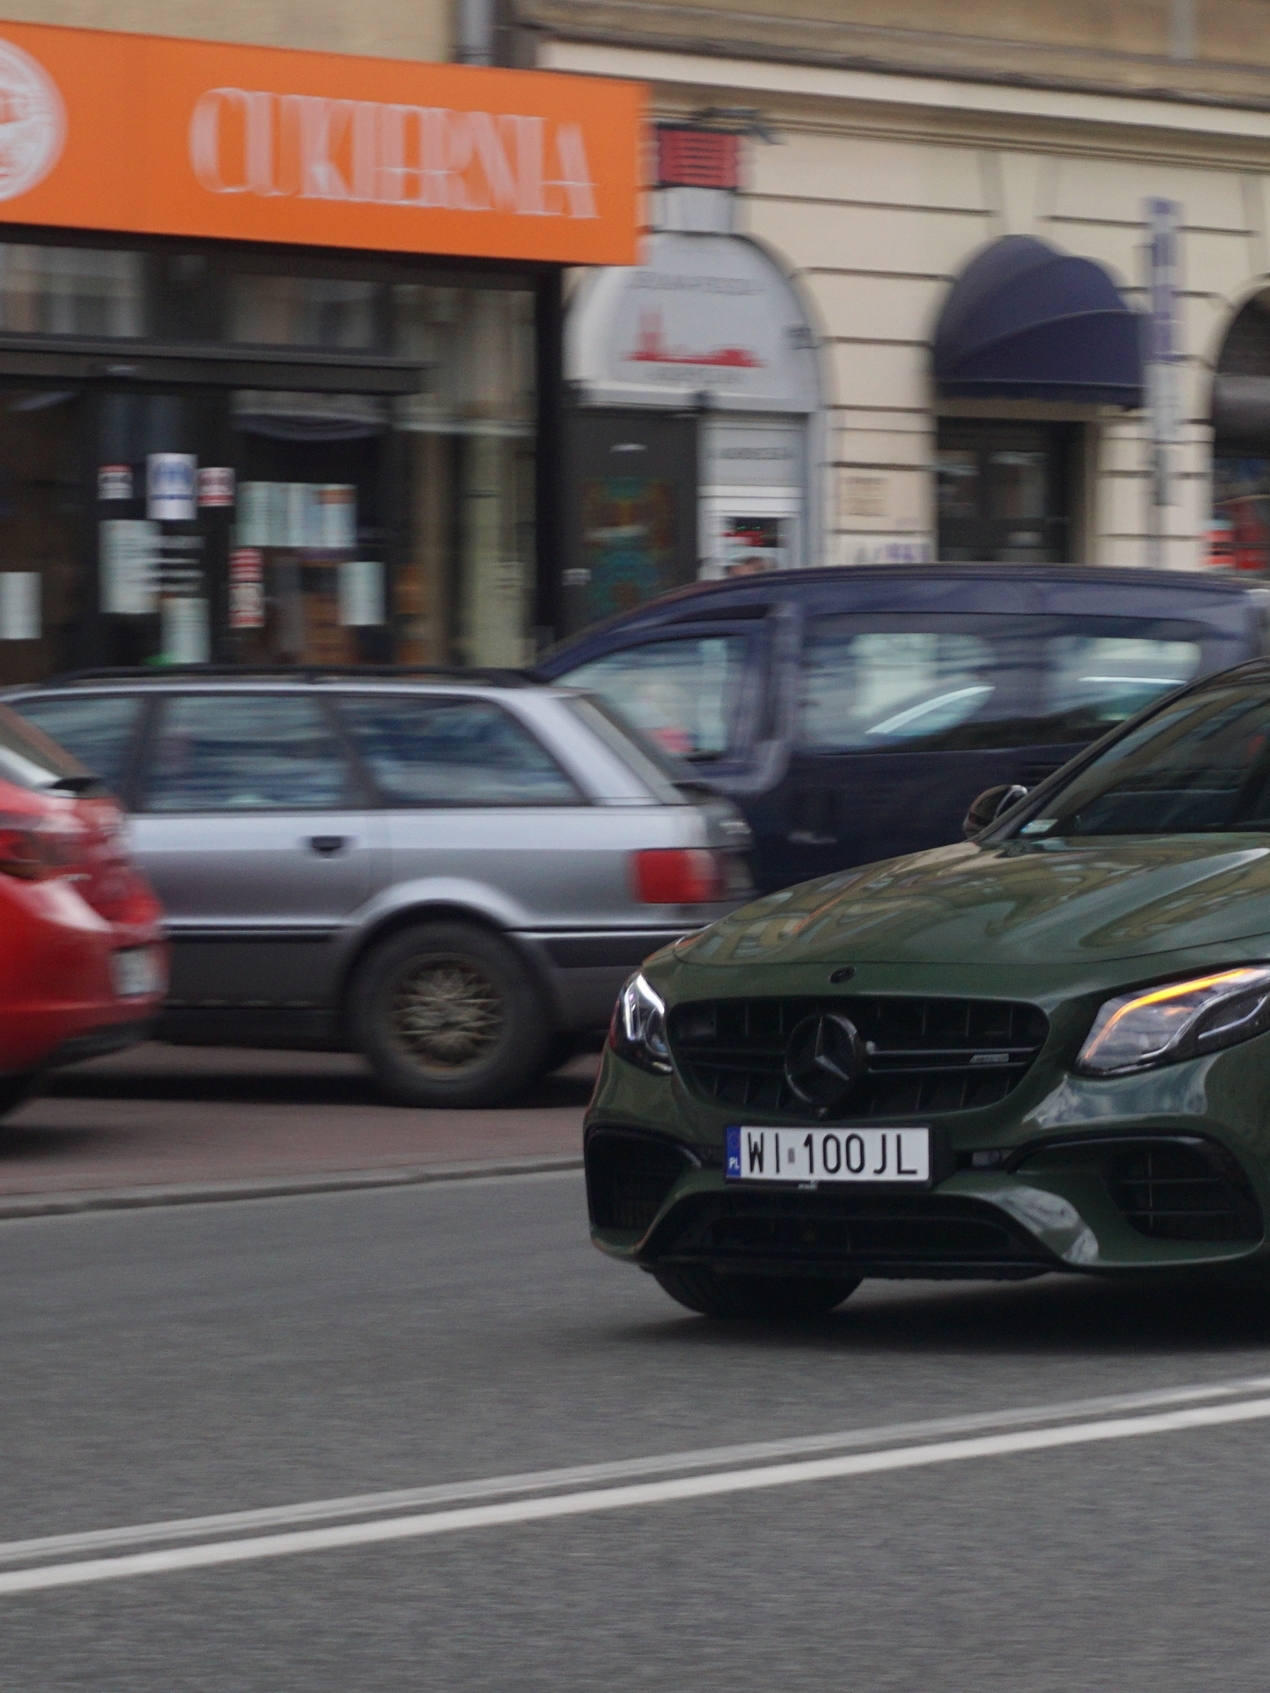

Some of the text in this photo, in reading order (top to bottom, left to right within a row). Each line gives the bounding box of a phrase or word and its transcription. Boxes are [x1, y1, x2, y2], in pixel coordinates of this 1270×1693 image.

[189, 87, 600, 219] CUKIERNIA
[729, 1157, 740, 1168] PL
[747, 1132, 918, 1174] WI 100JL
